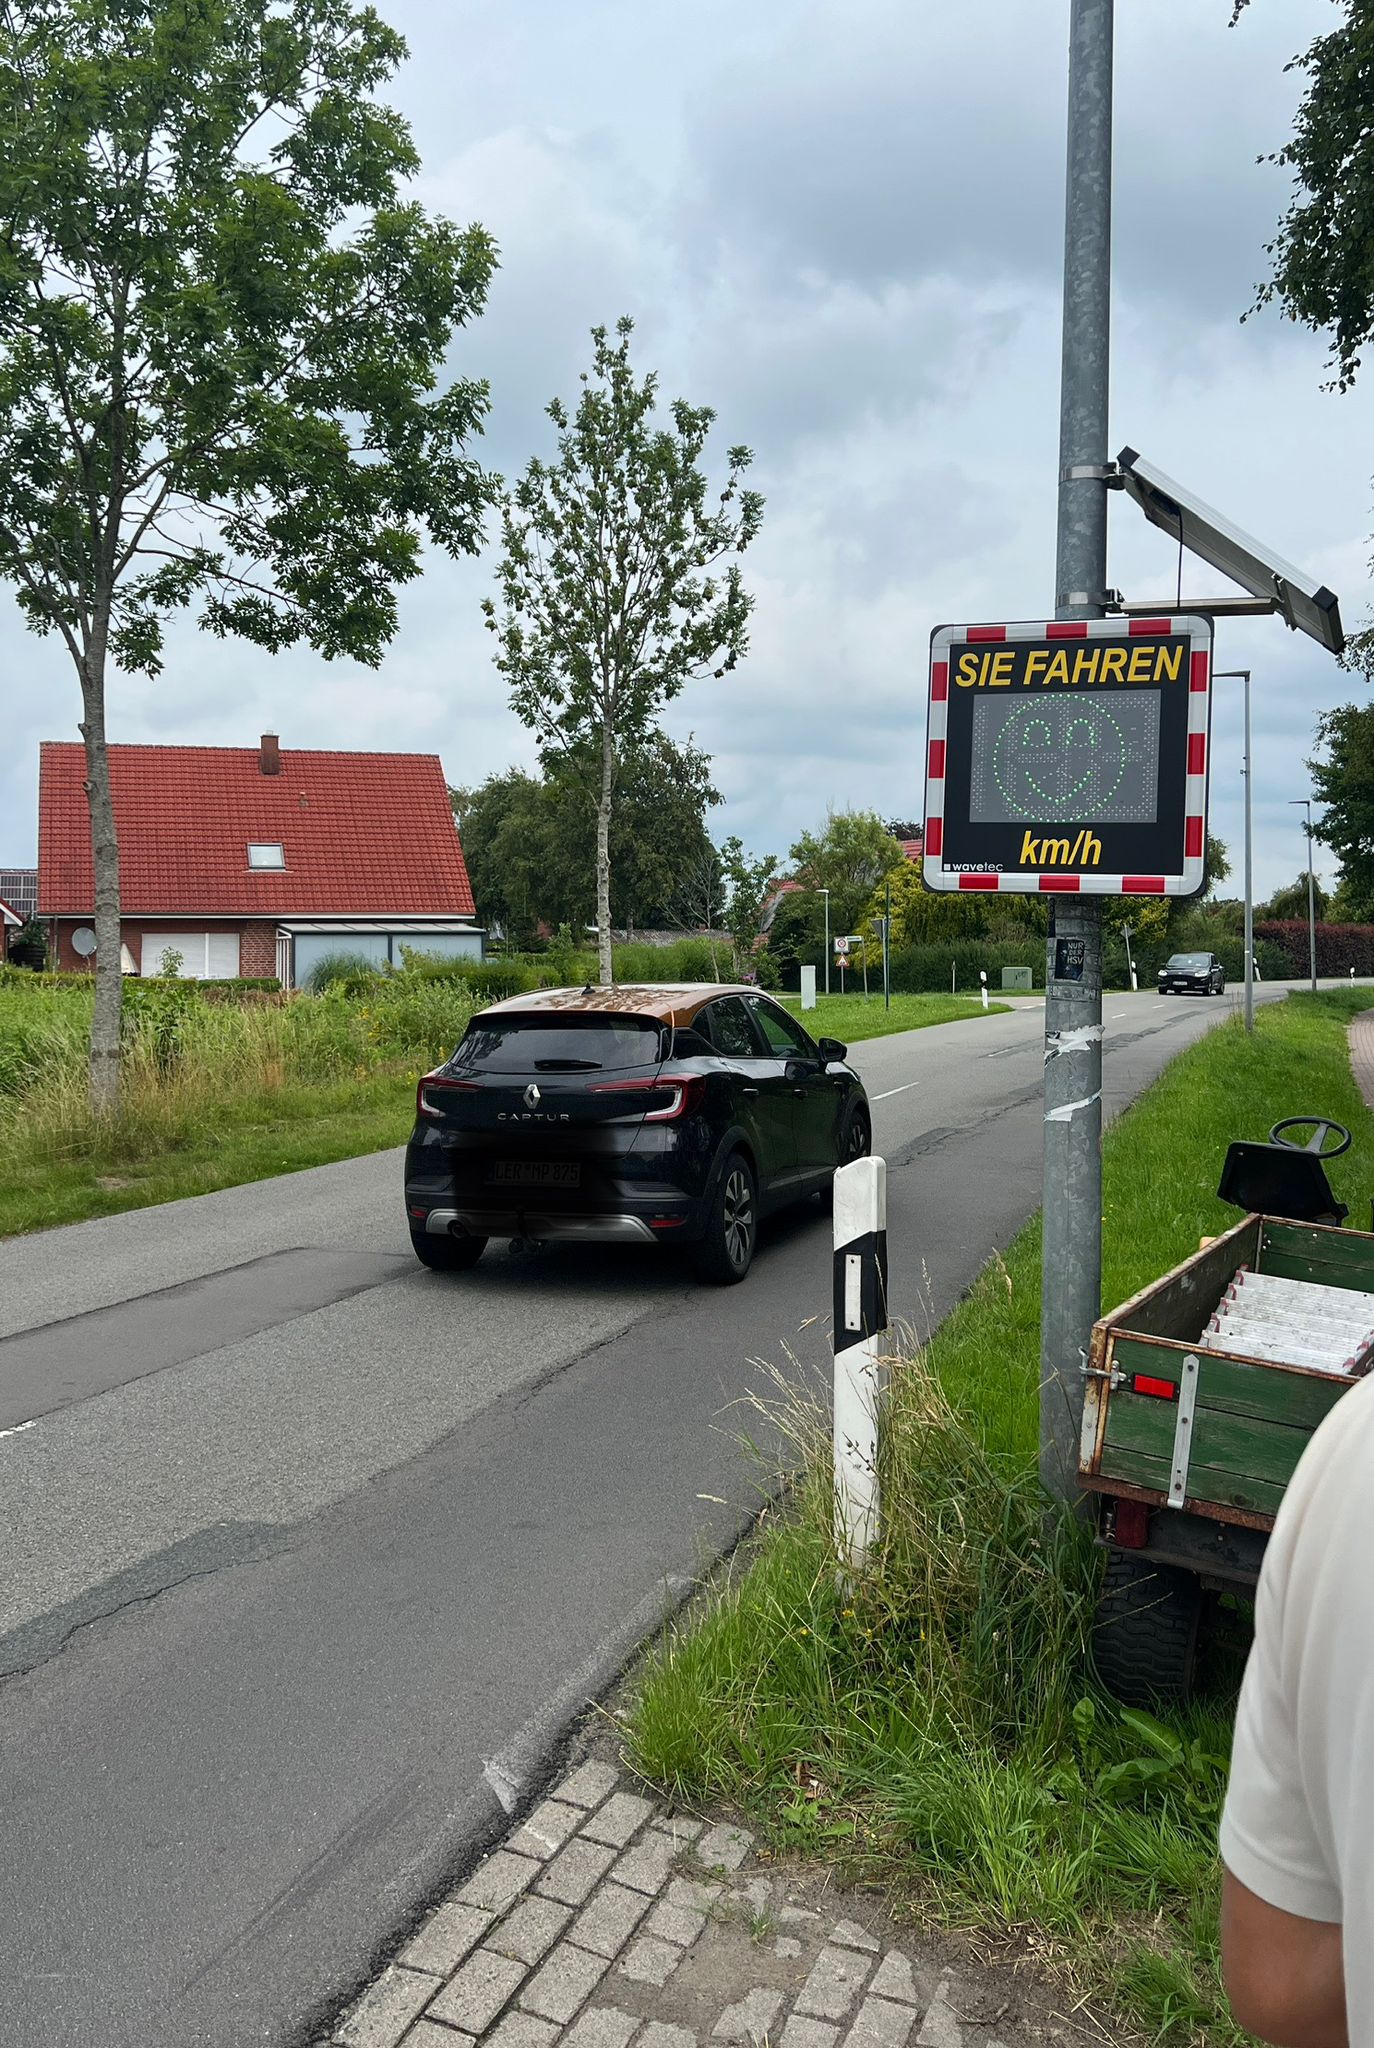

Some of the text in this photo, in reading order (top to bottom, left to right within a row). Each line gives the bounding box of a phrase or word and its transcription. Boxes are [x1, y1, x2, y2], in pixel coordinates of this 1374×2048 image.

[955, 645, 1183, 687] SIE FAHREN
[1019, 830, 1102, 866] km/h
[952, 862, 1004, 872] wavetec
[1067, 942, 1084, 950] NUR
[1067, 955, 1084, 964] HSV
[497, 1112, 570, 1121] CAPTUR
